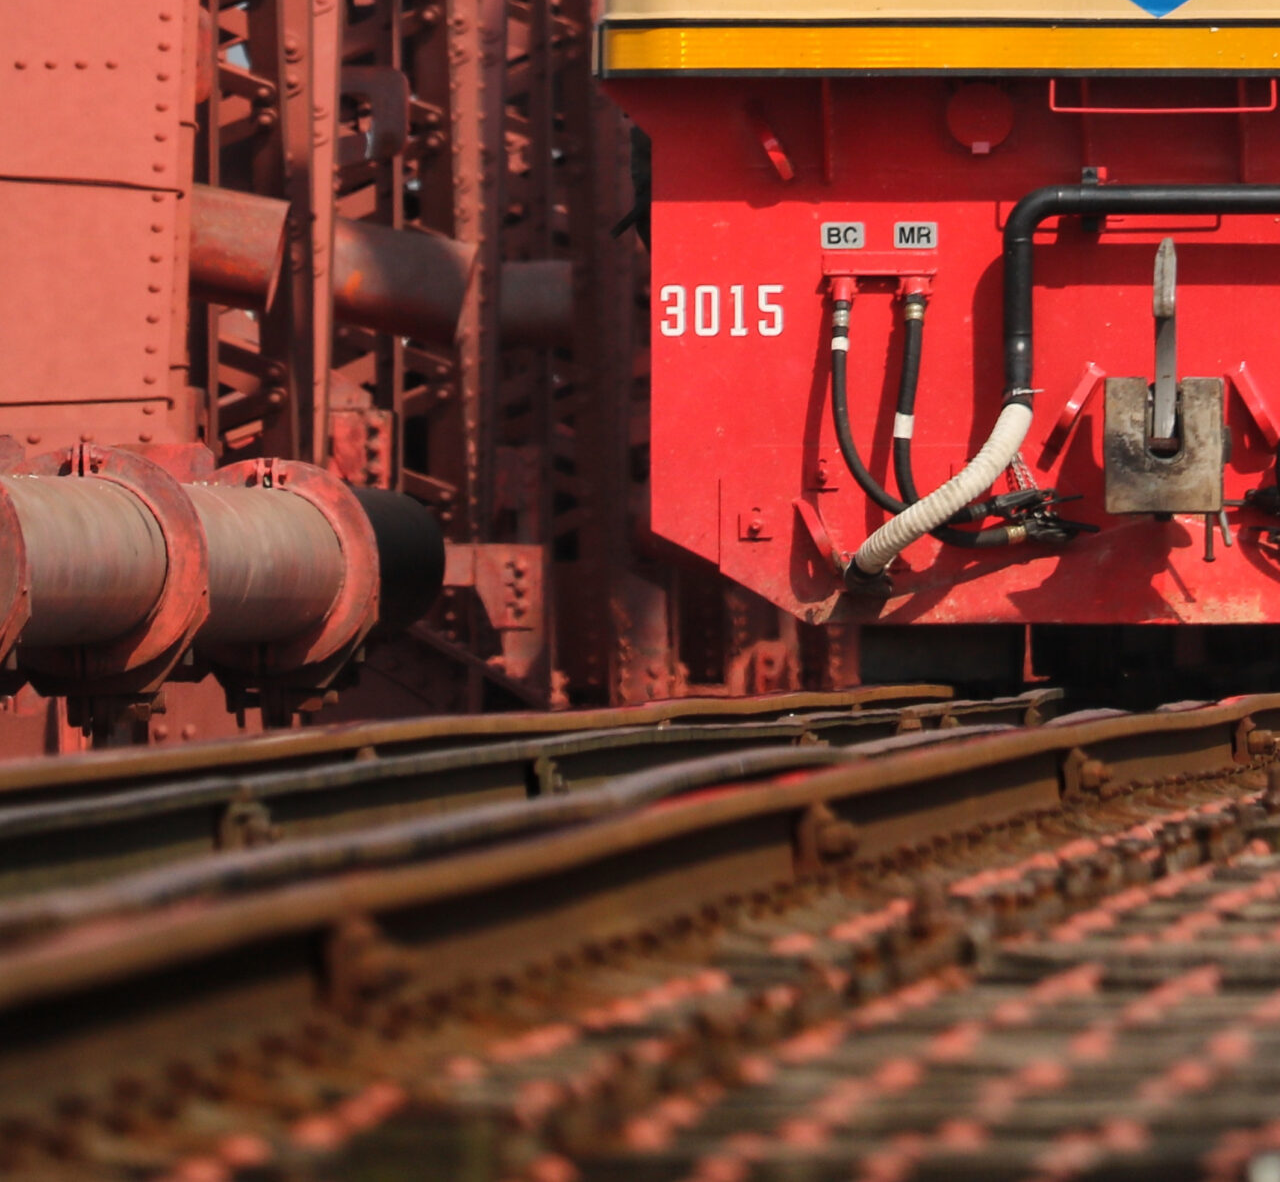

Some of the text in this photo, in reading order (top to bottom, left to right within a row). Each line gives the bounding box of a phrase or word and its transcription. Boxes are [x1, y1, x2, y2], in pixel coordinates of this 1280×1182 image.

[826, 226, 858, 245] BC
[898, 226, 932, 245] MR
[660, 284, 784, 337] 3015
